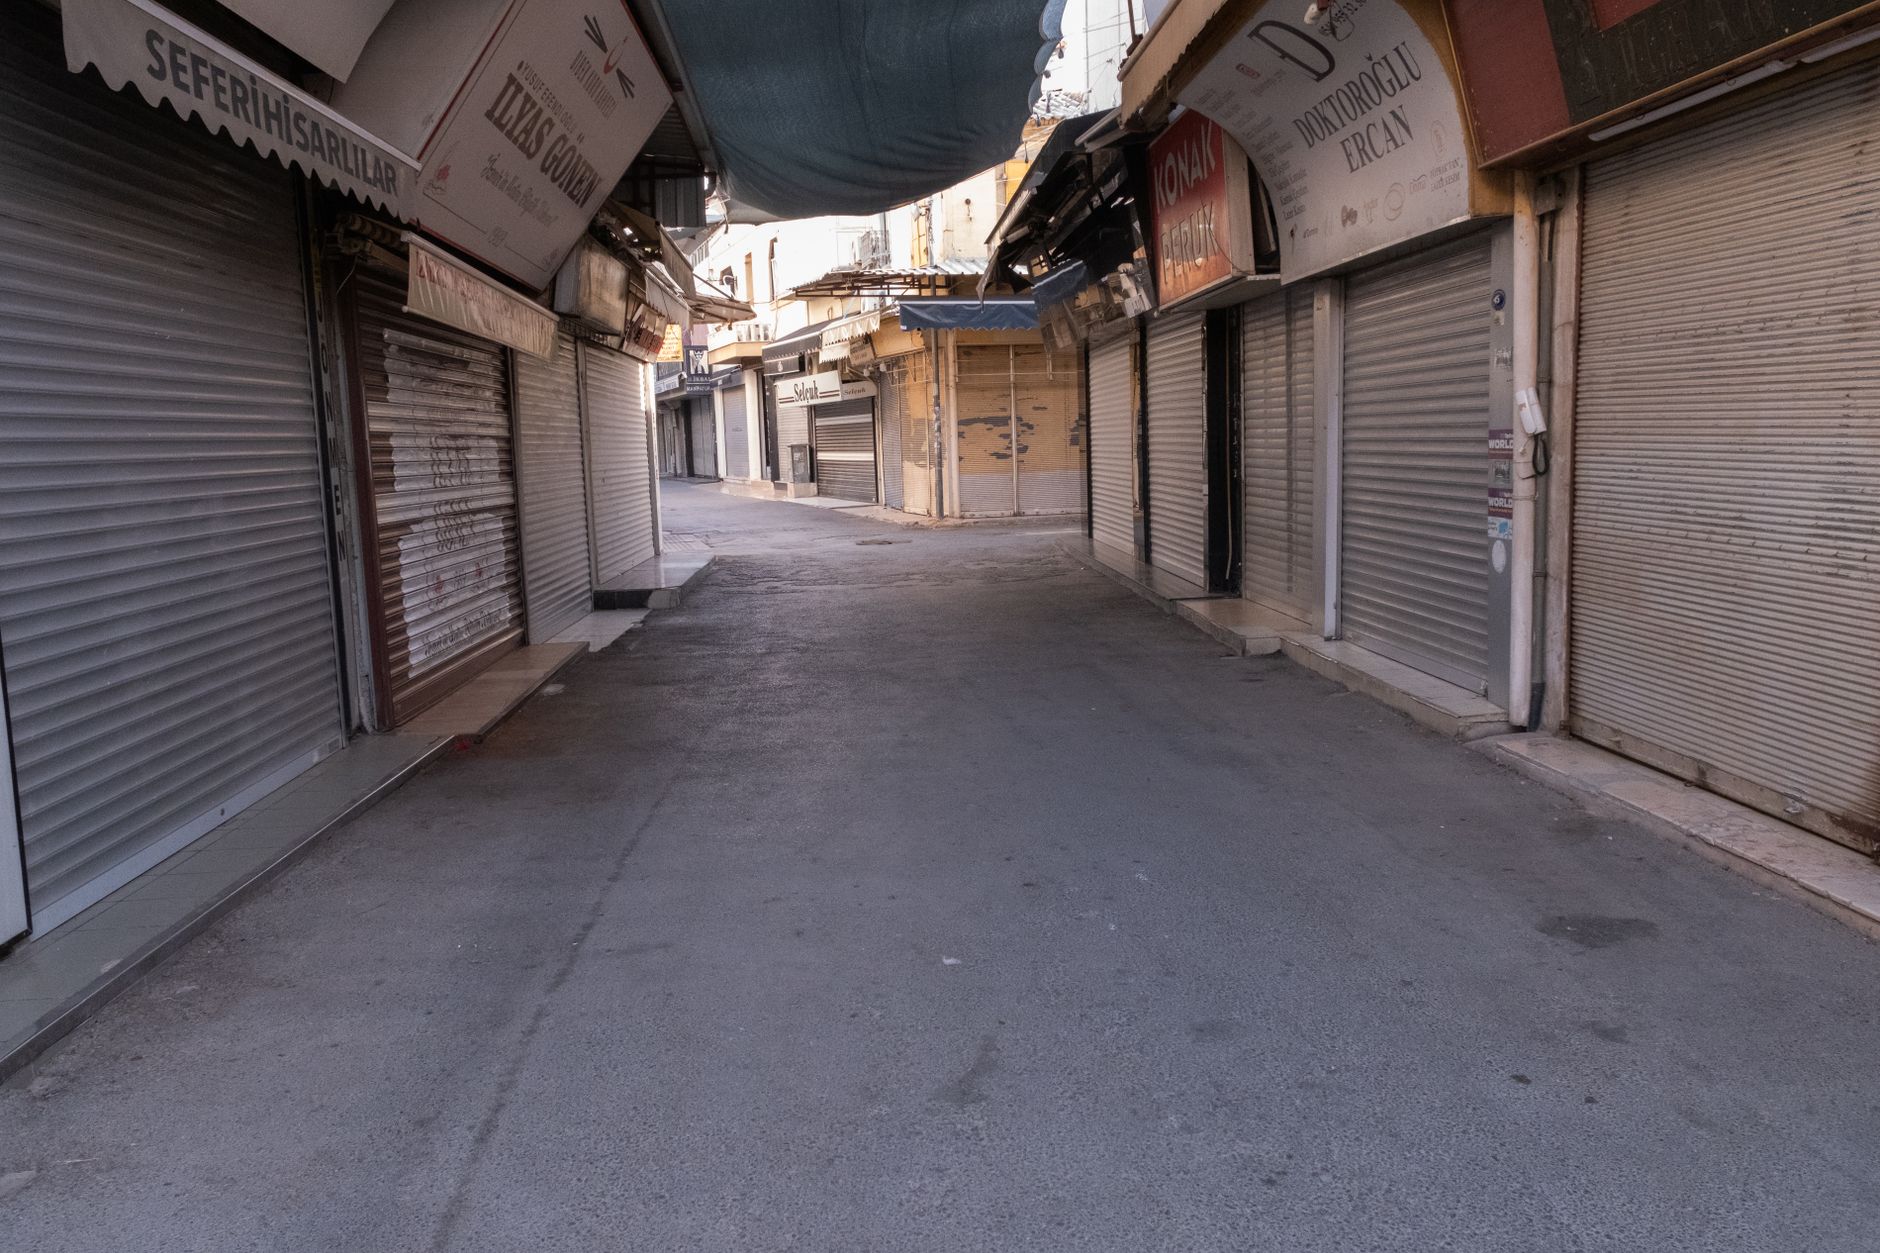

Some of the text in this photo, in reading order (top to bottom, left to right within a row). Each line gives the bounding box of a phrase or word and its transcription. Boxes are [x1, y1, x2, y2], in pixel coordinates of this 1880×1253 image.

[145, 29, 398, 197] SEFERİHİSARLILAR
[522, 62, 545, 93] YUSUF
[1293, 41, 1422, 149] DOKTOROĞLU
[540, 132, 603, 209] GÖNEN
[1154, 118, 1216, 210] KONAK
[1340, 104, 1414, 173] ERCAN
[1161, 200, 1218, 284] PERUK
[793, 380, 819, 404] Selçuk
[844, 387, 866, 396] Selçuk
